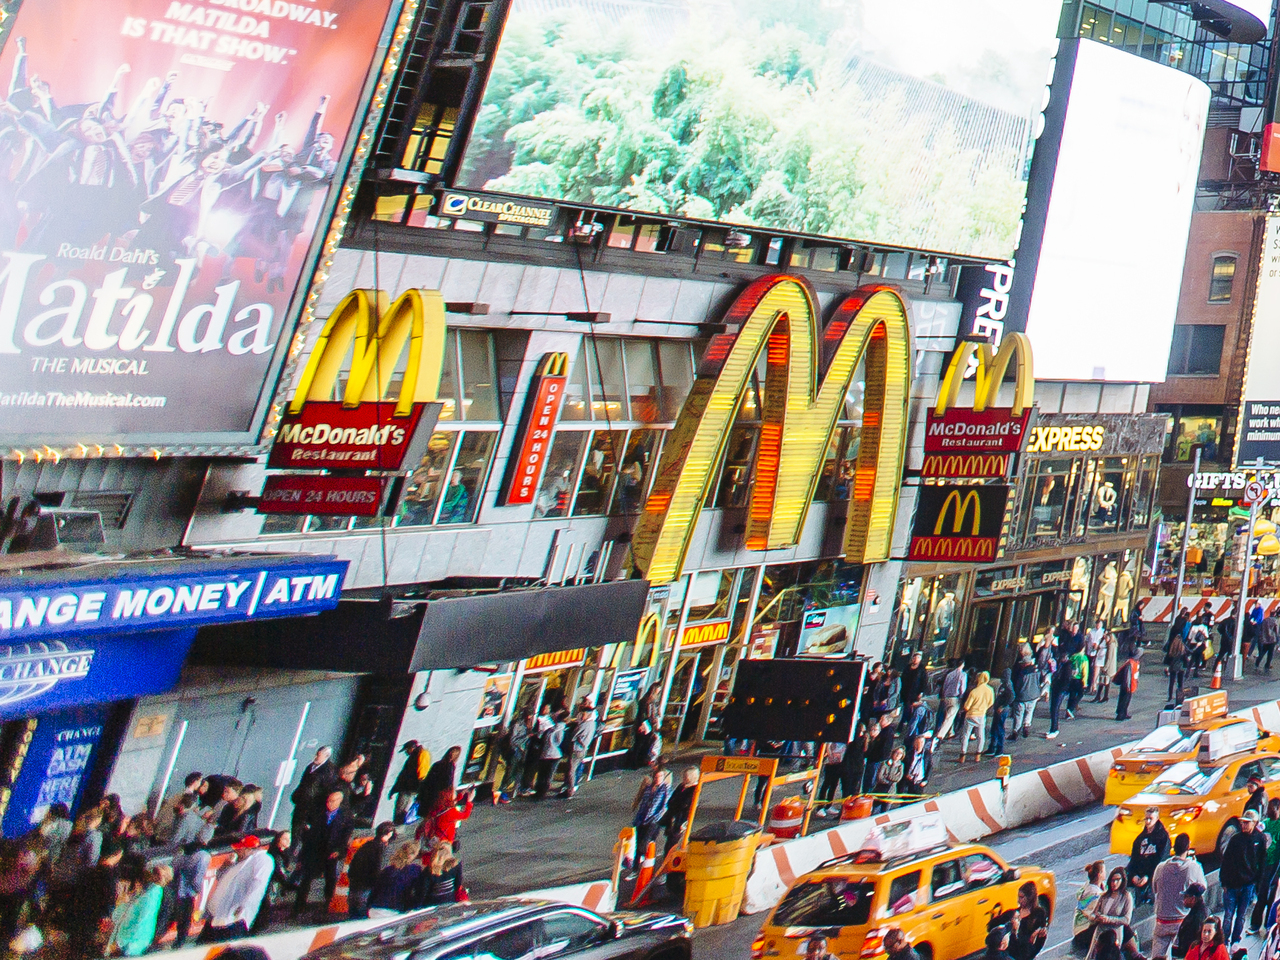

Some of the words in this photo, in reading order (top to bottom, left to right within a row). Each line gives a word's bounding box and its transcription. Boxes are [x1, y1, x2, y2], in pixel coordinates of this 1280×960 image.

[164, 1, 270, 38] MATILDA
[209, 0, 338, 29] ROADWAY.
[121, 16, 147, 37] IS
[149, 20, 217, 50] THAT
[56, 242, 108, 261] Roald
[109, 246, 161, 265] Dahl's
[1269, 269, 1277, 277] or
[32, 357, 69, 373] THE
[70, 358, 149, 376] MUSICAL
[0, 391, 167, 408] atildaTheMusical.com
[540, 383, 558, 426] OPEN
[1251, 404, 1269, 415] Who
[928, 421, 1021, 437] McDonald's
[1249, 417, 1269, 428] work
[276, 422, 406, 447] McDonald's
[533, 429, 549, 440] 24
[941, 438, 1003, 447] Restaurant
[291, 448, 378, 462] Restaurant
[520, 443, 542, 498] HOURS
[1187, 472, 1247, 490] GIFTS
[264, 490, 301, 502] OPEN
[305, 490, 323, 502] 24
[325, 490, 376, 504] HOURS
[991, 576, 1026, 592] EXPRESS
[112, 580, 252, 620] MONEY
[264, 573, 339, 604] ATM
